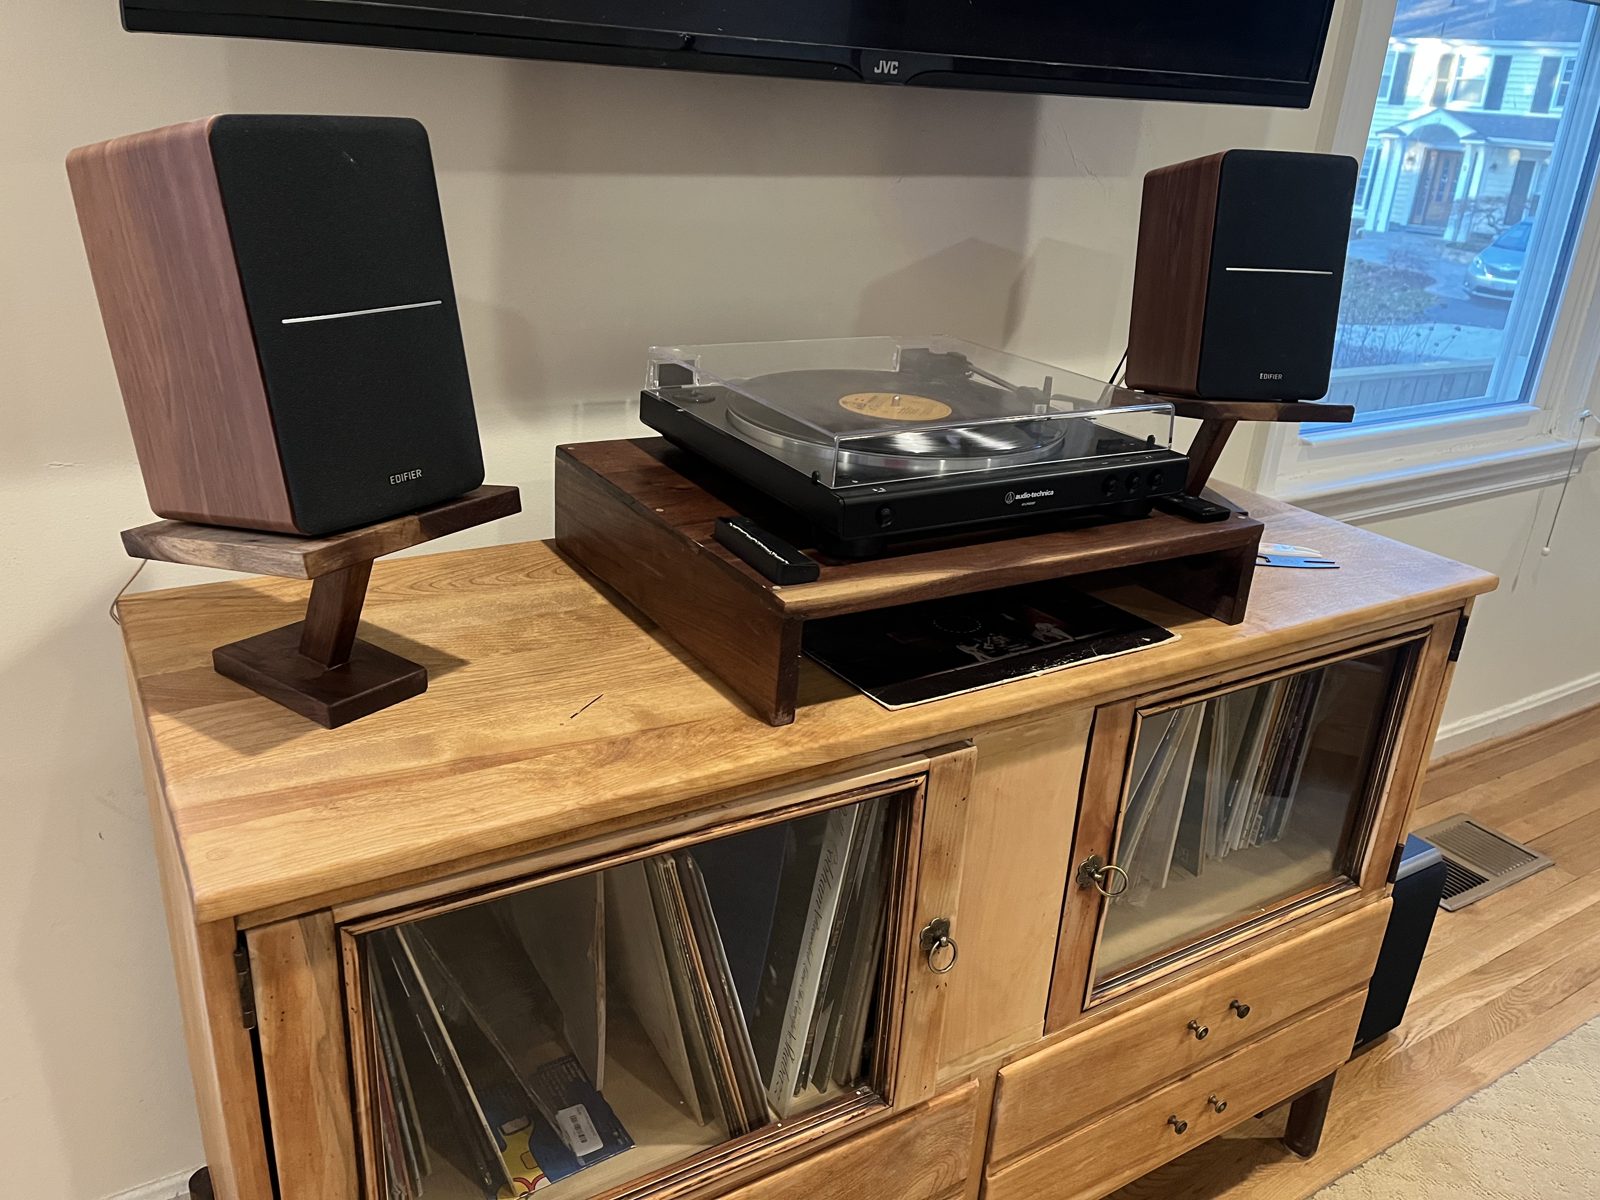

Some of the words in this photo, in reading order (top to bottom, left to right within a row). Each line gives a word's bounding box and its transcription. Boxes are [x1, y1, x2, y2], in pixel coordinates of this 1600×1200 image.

[874, 60, 899, 75] JVC
[1259, 372, 1283, 380] EDIFIER
[390, 469, 422, 485] EDIFIER
[1015, 490, 1055, 500] audio-technica
